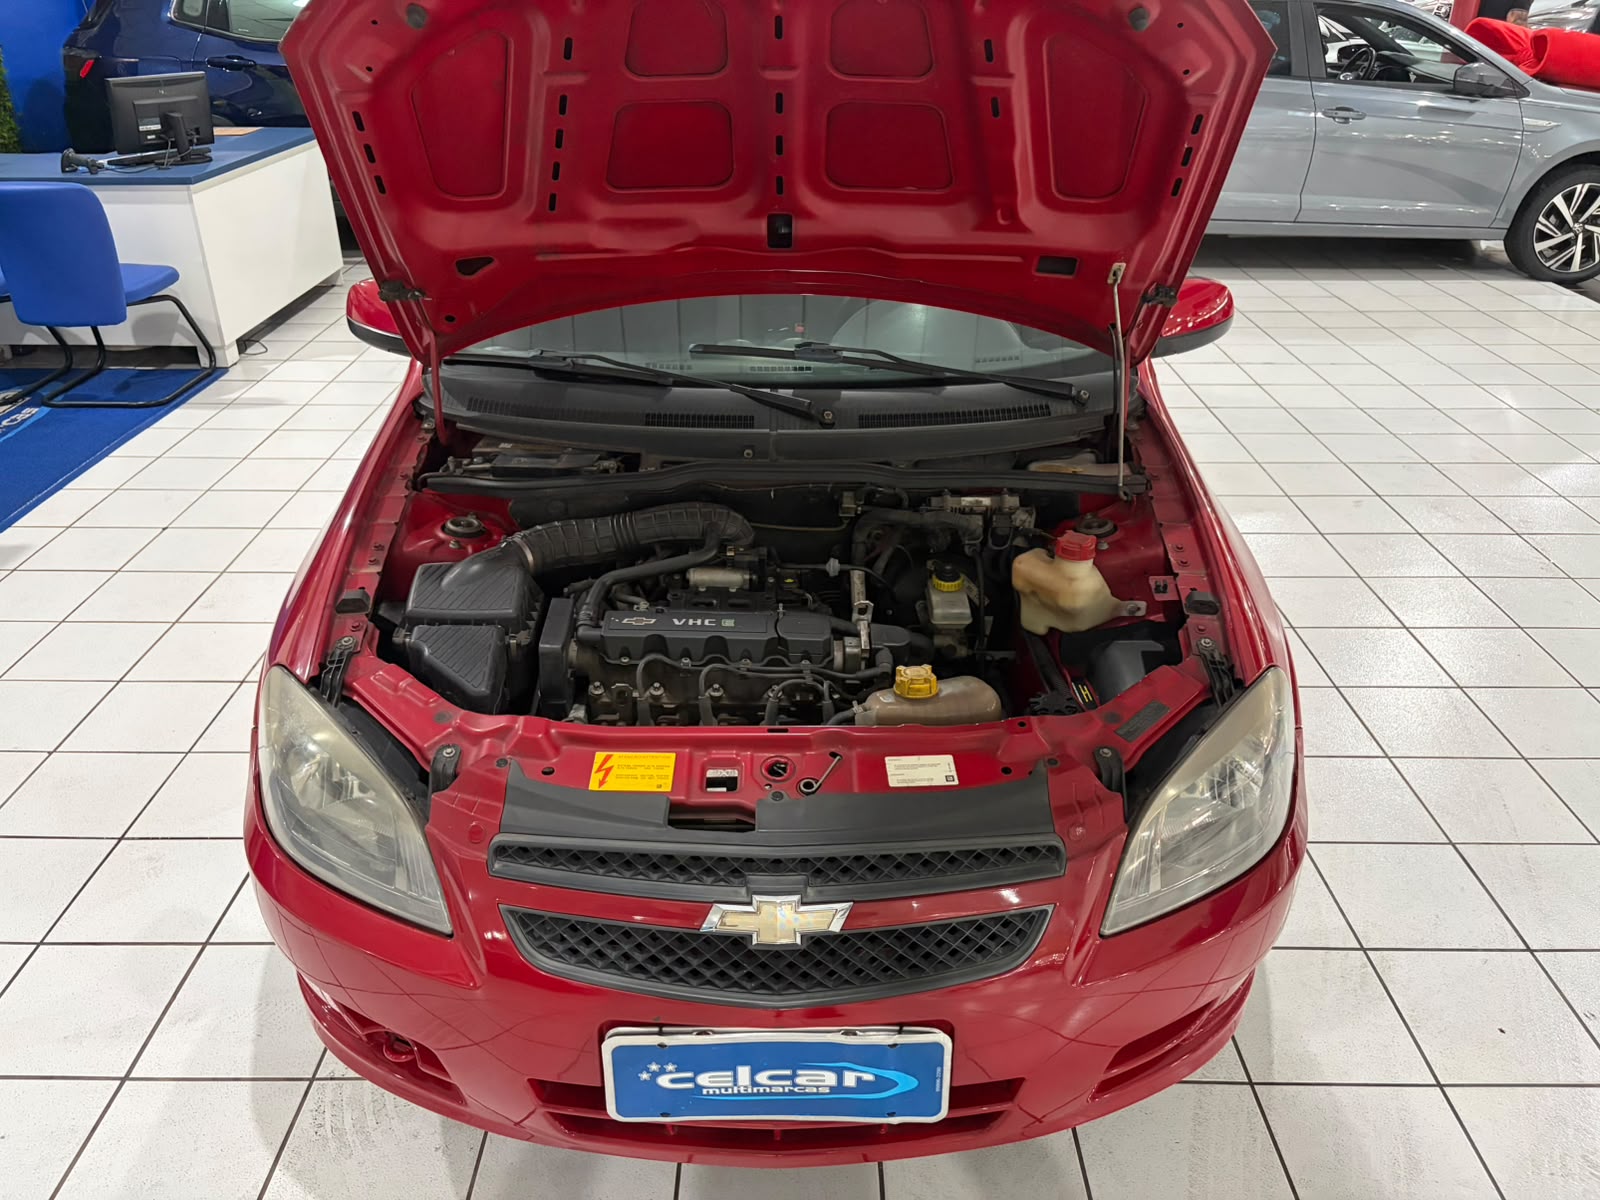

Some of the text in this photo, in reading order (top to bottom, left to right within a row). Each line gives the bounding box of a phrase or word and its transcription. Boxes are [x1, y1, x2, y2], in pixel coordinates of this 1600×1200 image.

[672, 618, 717, 626] VHC
[656, 1065, 876, 1090] celcar
[702, 1085, 831, 1095] multimarcas
